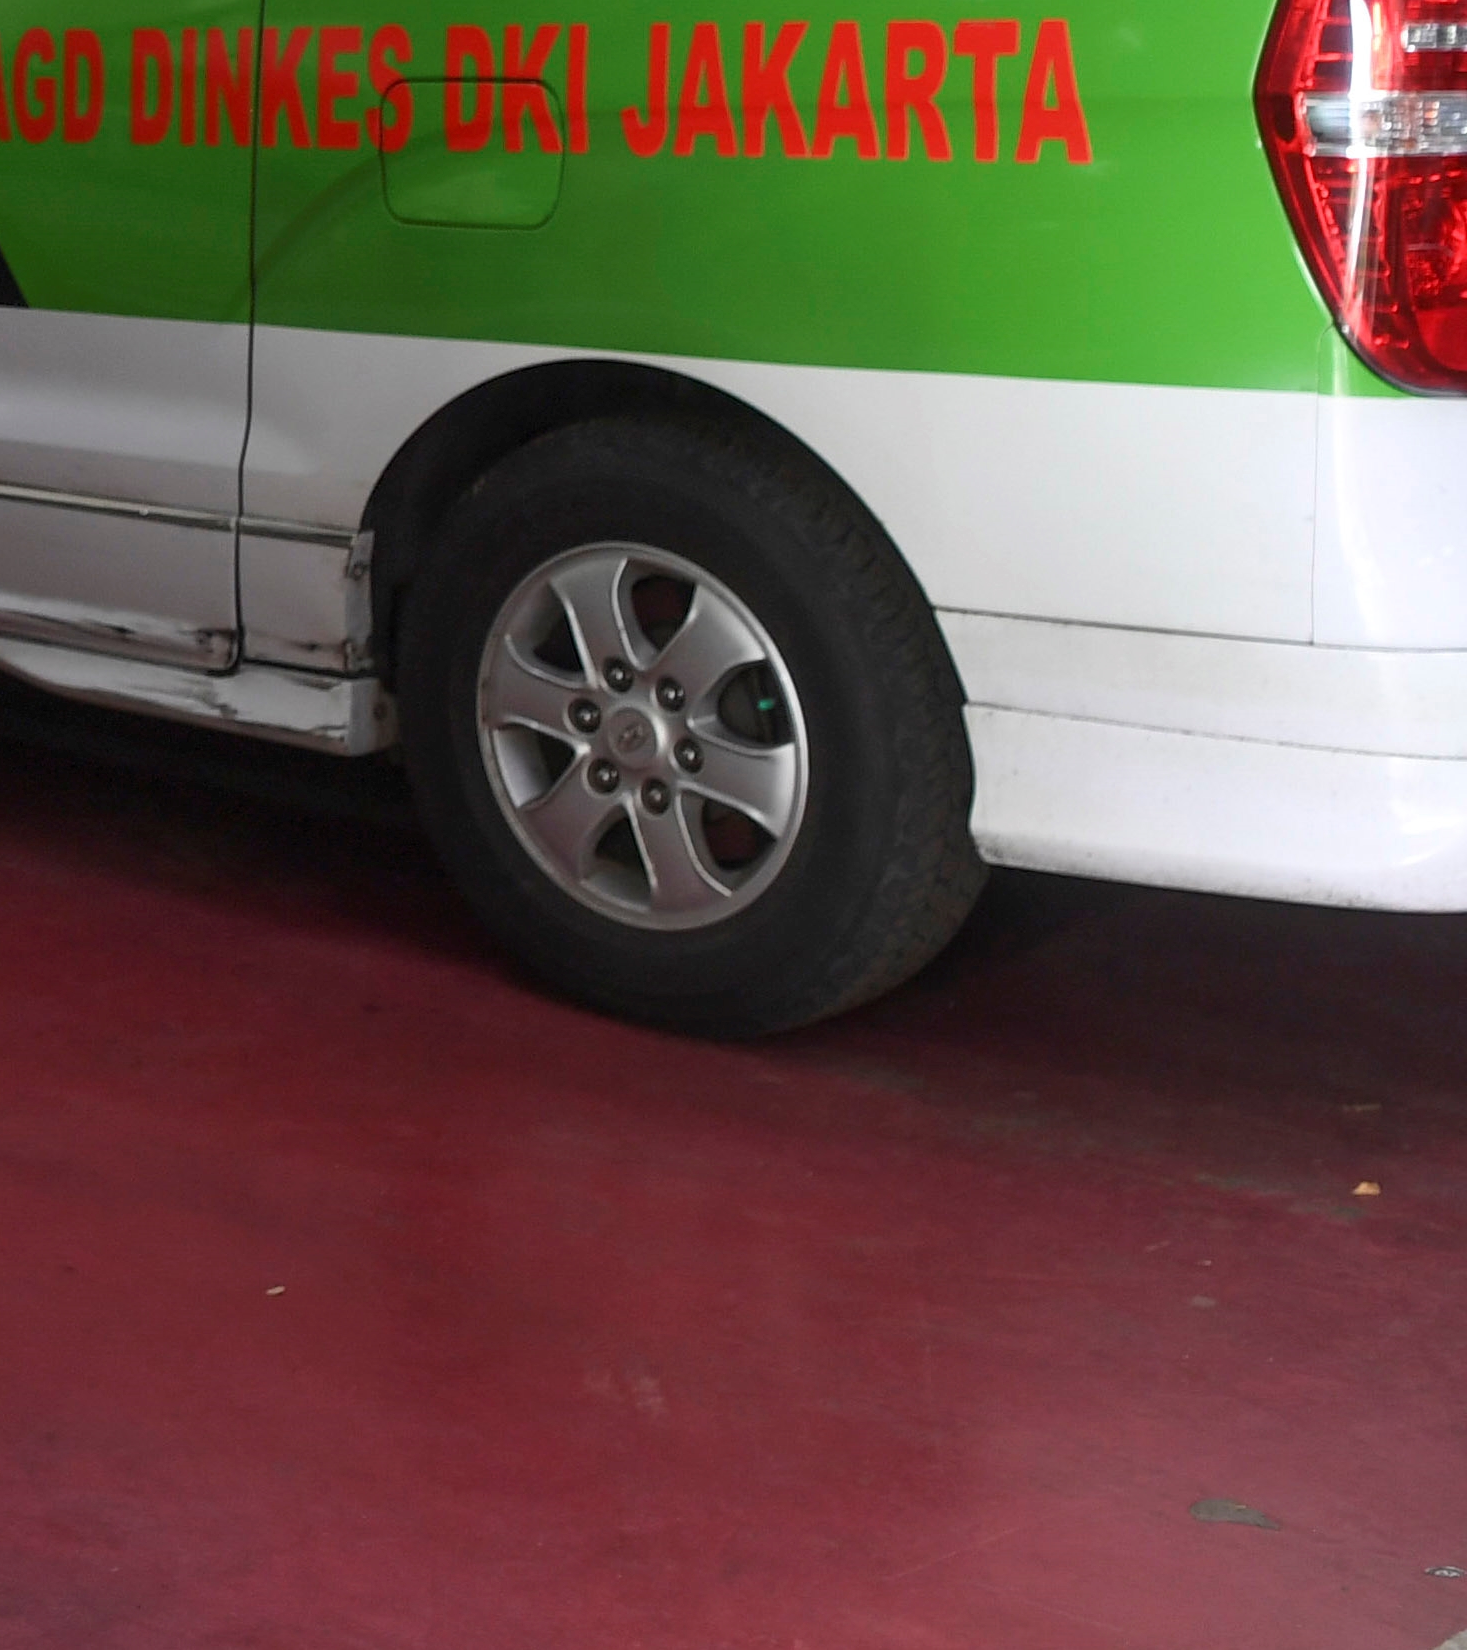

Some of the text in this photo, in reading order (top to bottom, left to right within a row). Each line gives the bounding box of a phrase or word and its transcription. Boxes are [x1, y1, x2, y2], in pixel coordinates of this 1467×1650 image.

[130, 23, 413, 153] DINKES
[444, 23, 588, 154] DKI
[620, 18, 1093, 164] JAKARTA
